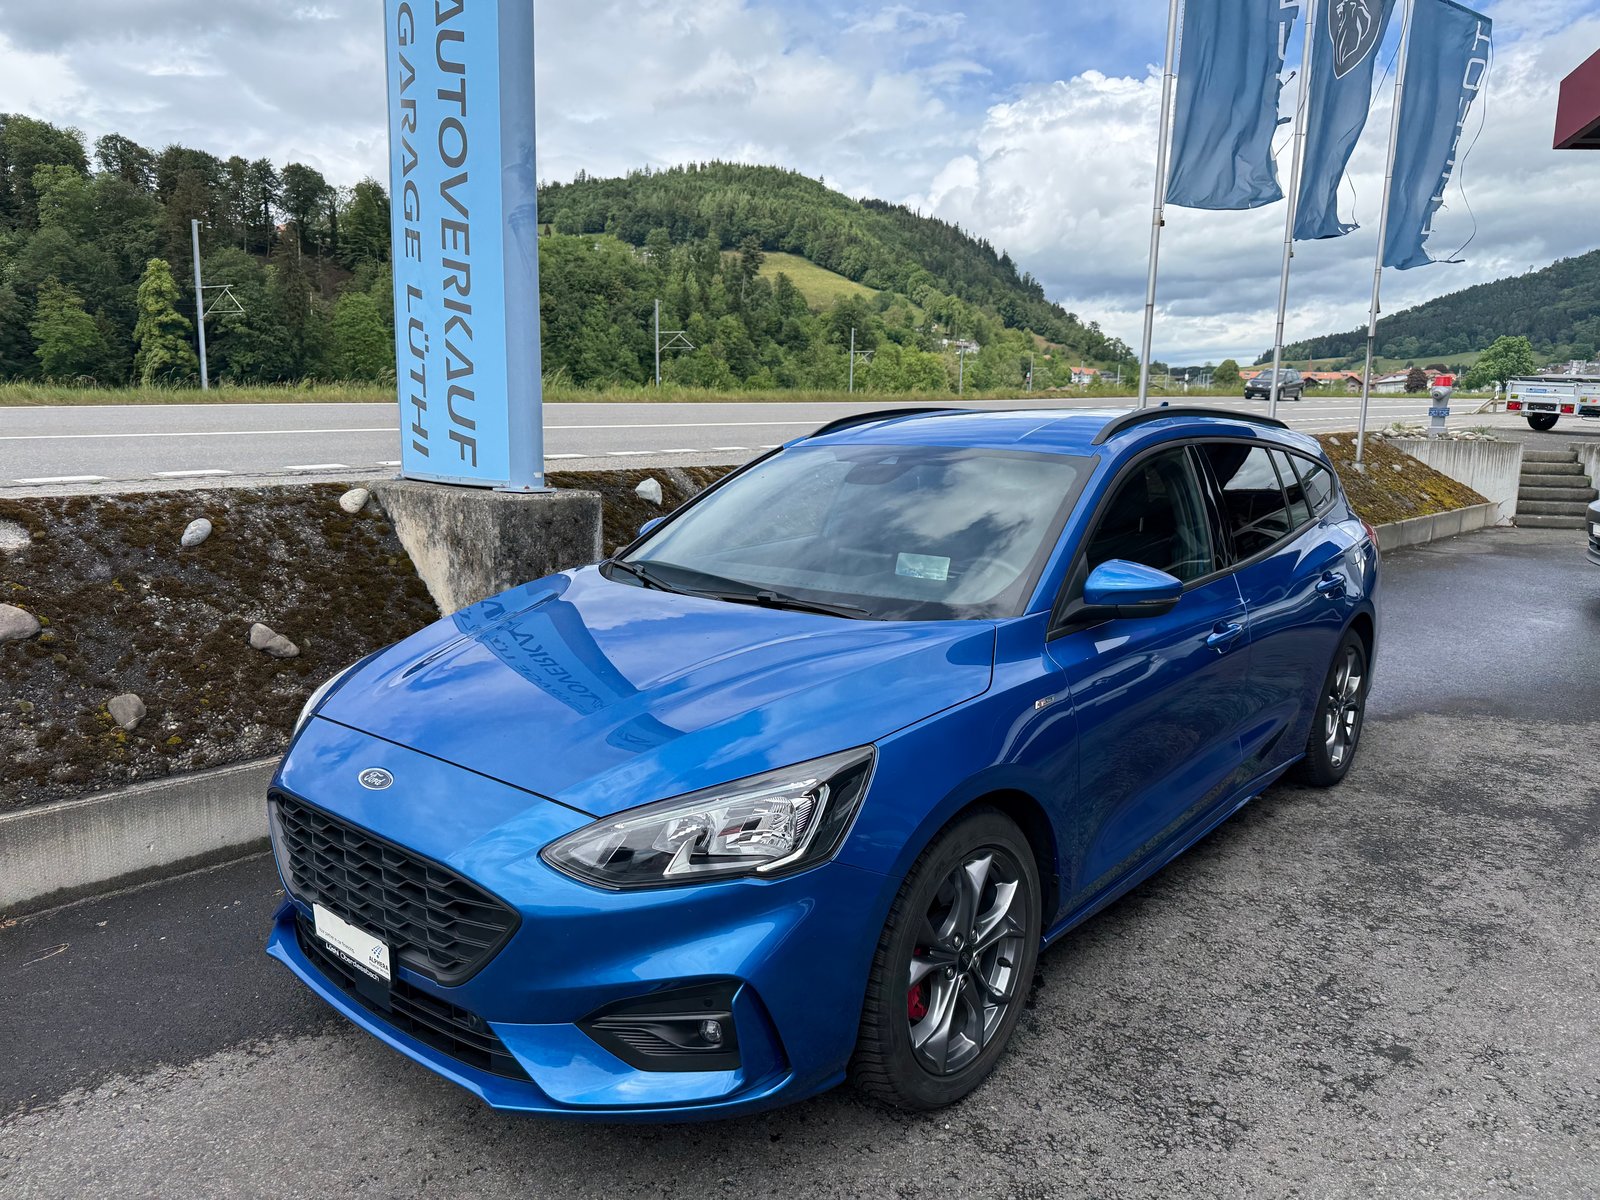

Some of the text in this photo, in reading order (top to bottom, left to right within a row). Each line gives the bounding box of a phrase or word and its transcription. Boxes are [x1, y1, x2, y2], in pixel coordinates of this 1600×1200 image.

[397, 2, 430, 458] GARAGE LÜTHI
[434, 0, 477, 468] AUTOVERKAUF
[363, 771, 386, 786] Ford
